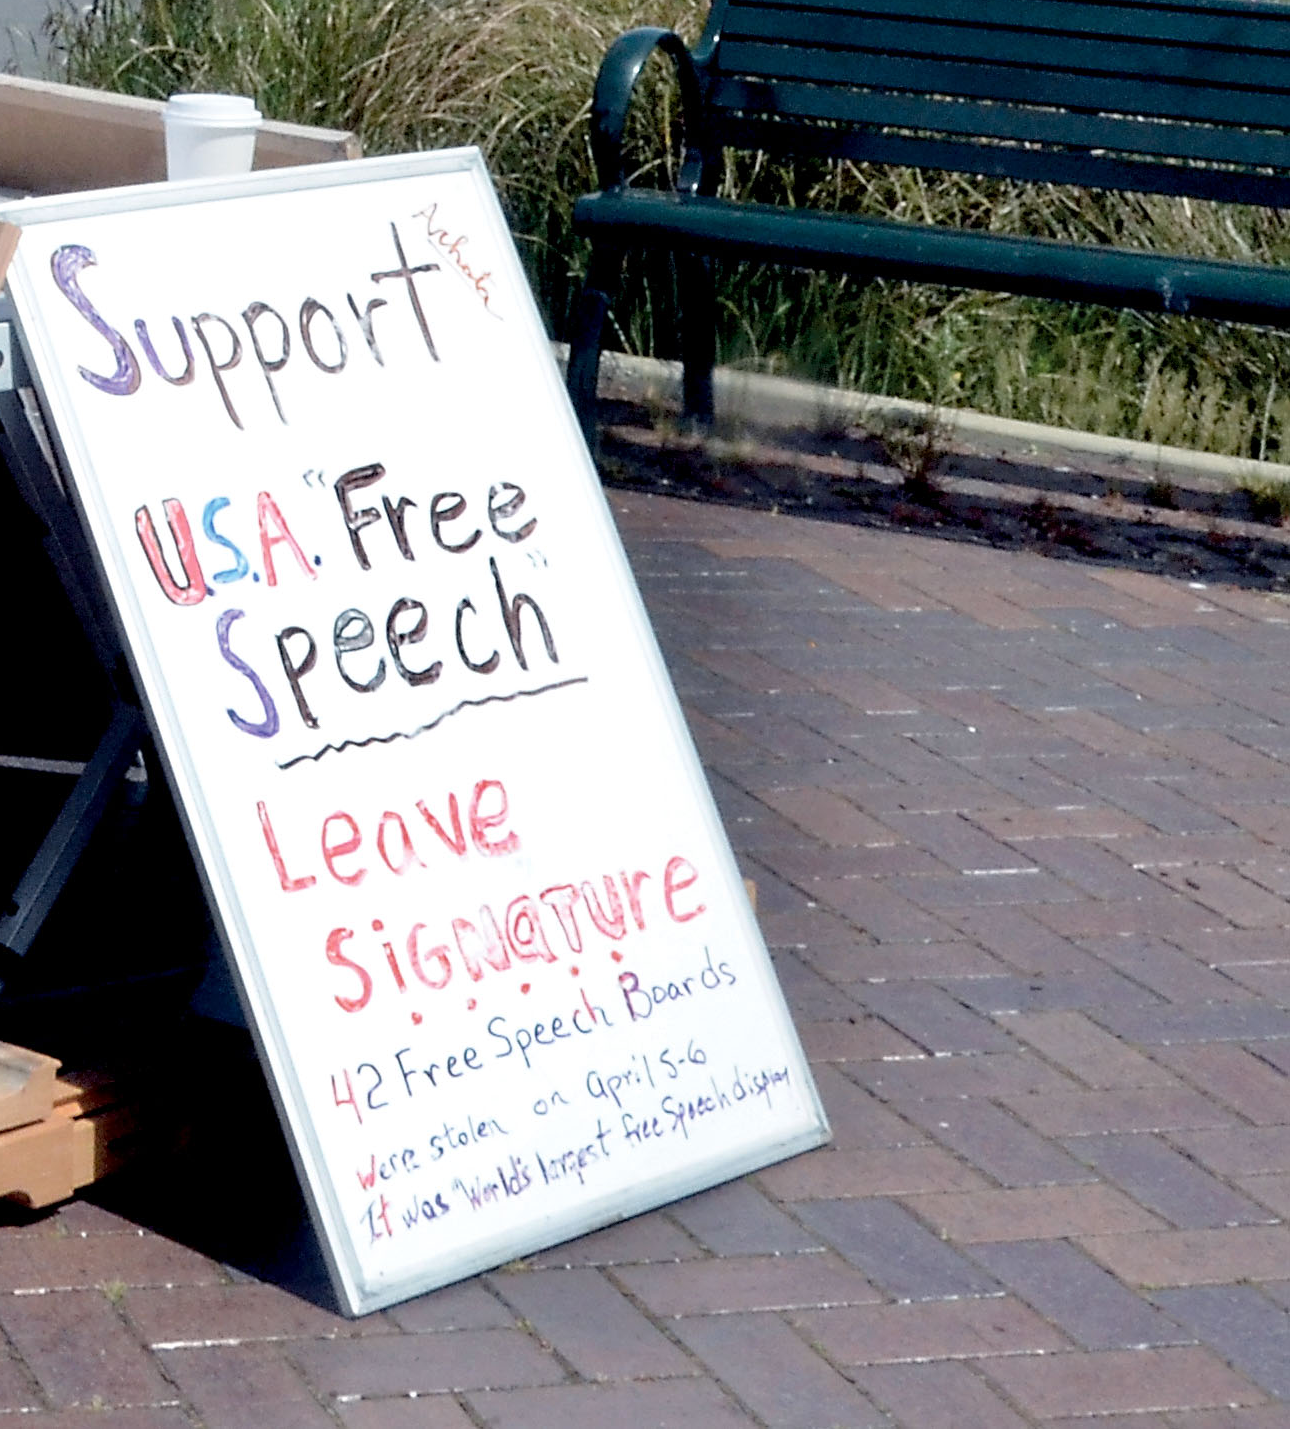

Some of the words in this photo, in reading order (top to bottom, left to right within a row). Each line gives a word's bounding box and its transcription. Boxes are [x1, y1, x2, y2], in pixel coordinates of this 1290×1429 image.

[50, 222, 441, 431] Support
[134, 490, 321, 606] U.S.A.
[257, 779, 520, 893] Leave
[331, 1063, 389, 1124] 42
[394, 1047, 483, 1097] Free
[487, 988, 614, 1069] Speech
[618, 945, 737, 1022] Boards
[359, 1194, 393, 1245] It
[402, 1192, 450, 1229] was
[535, 1119, 611, 1185] largest
[621, 1113, 664, 1145] free
[732, 1066, 790, 1110] display
[429, 1115, 509, 1161] stolen
[533, 1091, 570, 1116] on
